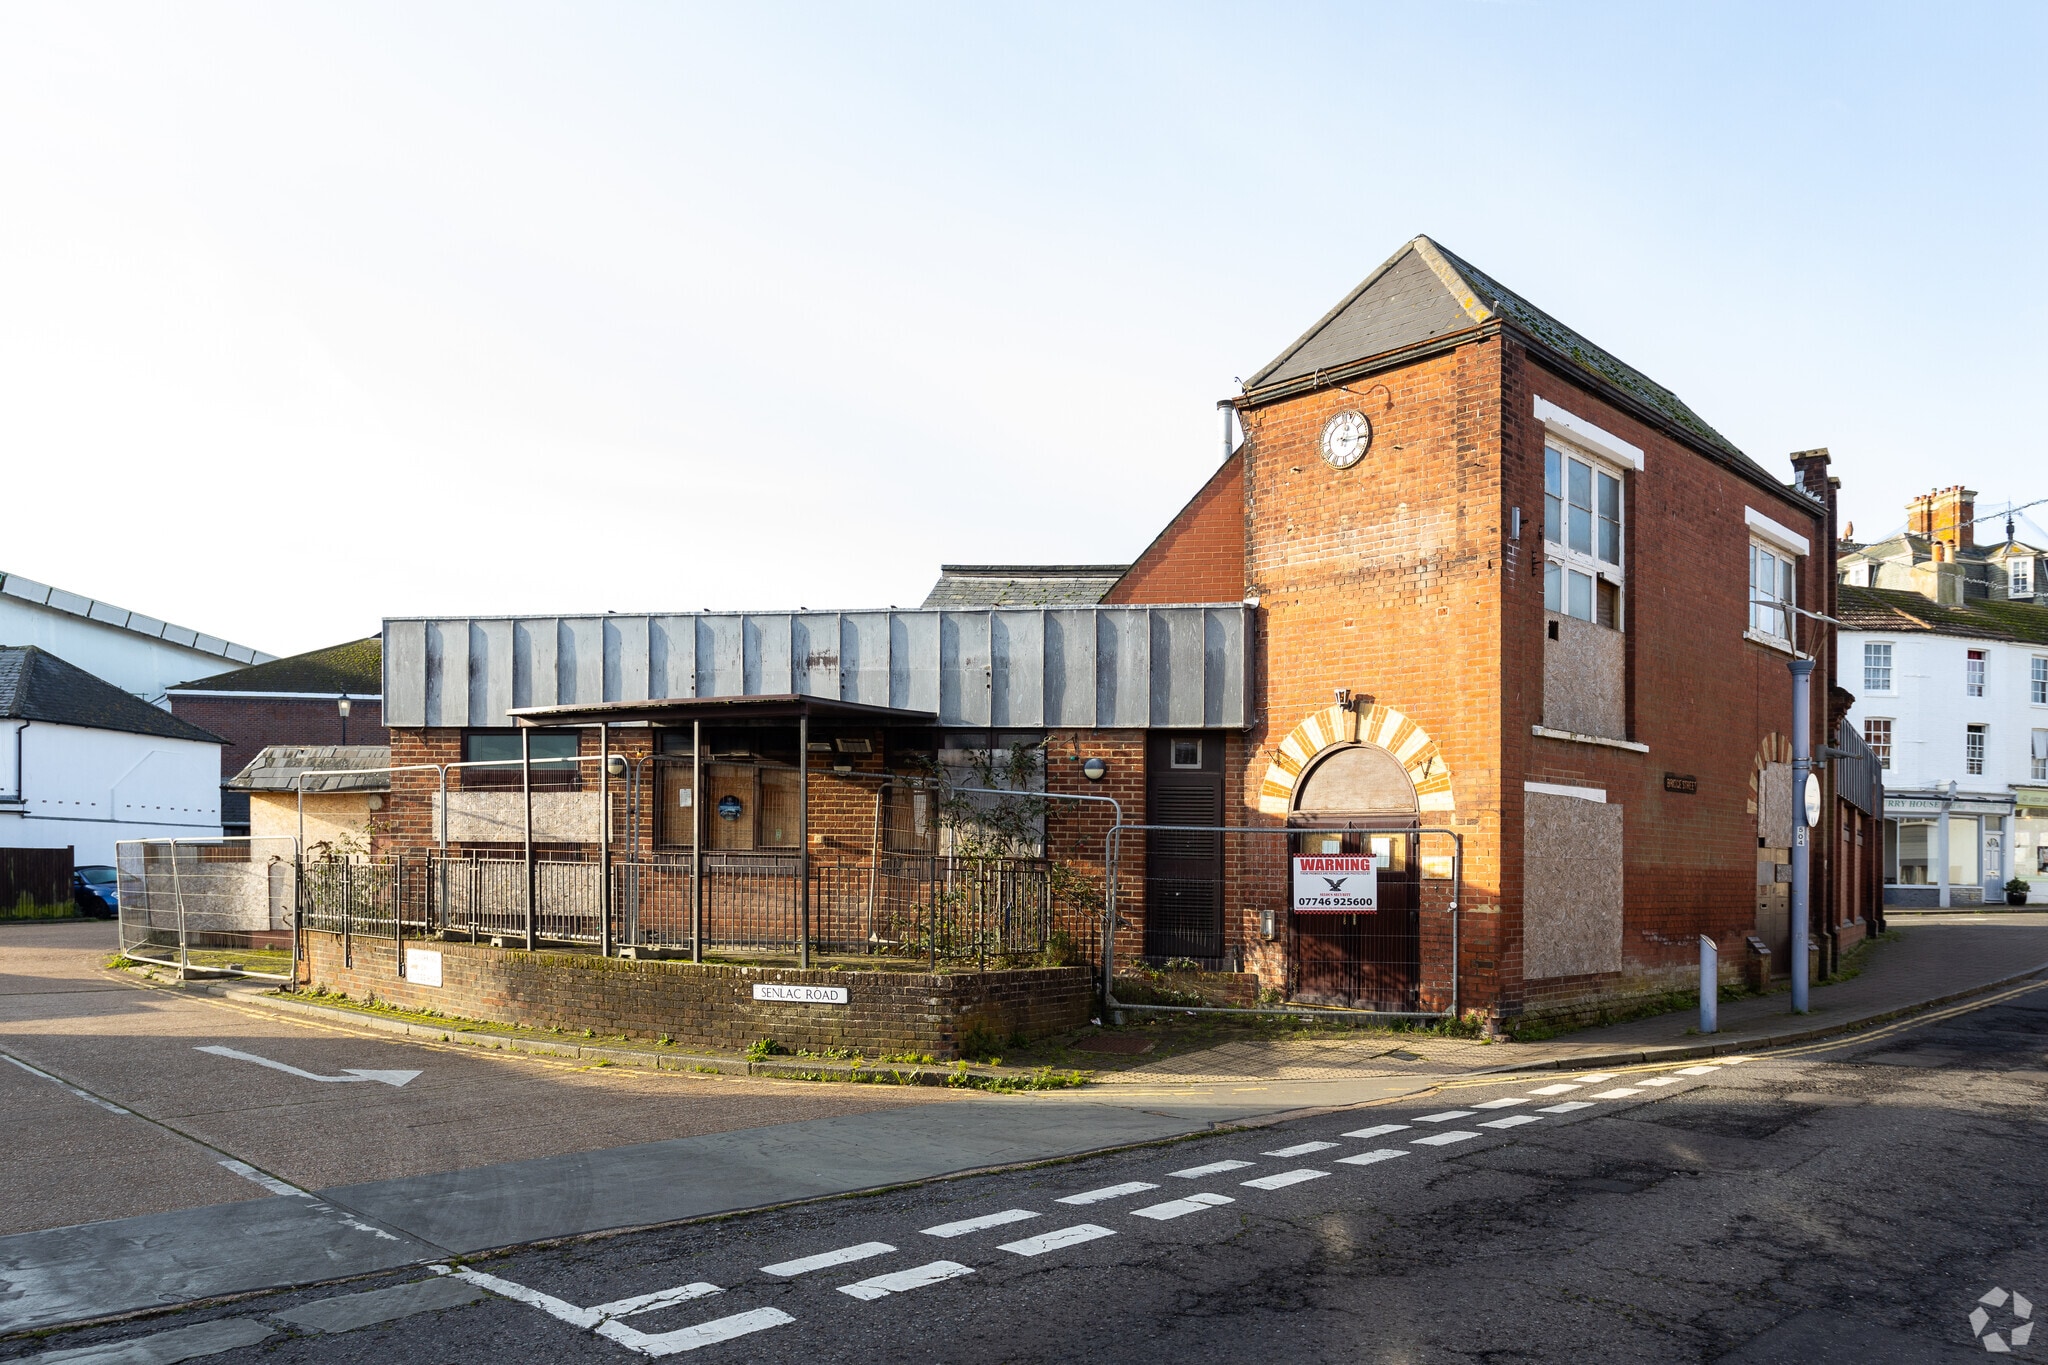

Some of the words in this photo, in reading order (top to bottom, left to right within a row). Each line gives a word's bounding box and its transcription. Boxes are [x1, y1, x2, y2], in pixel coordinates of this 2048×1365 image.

[1682, 780, 1697, 791] STREET
[1909, 800, 1940, 808] HOUSE
[1300, 859, 1370, 871] WARNING
[1299, 897, 1331, 906] 07746
[1333, 897, 1373, 906] 925600
[761, 987, 801, 999] SENLAC
[805, 989, 839, 1001] ROAD
